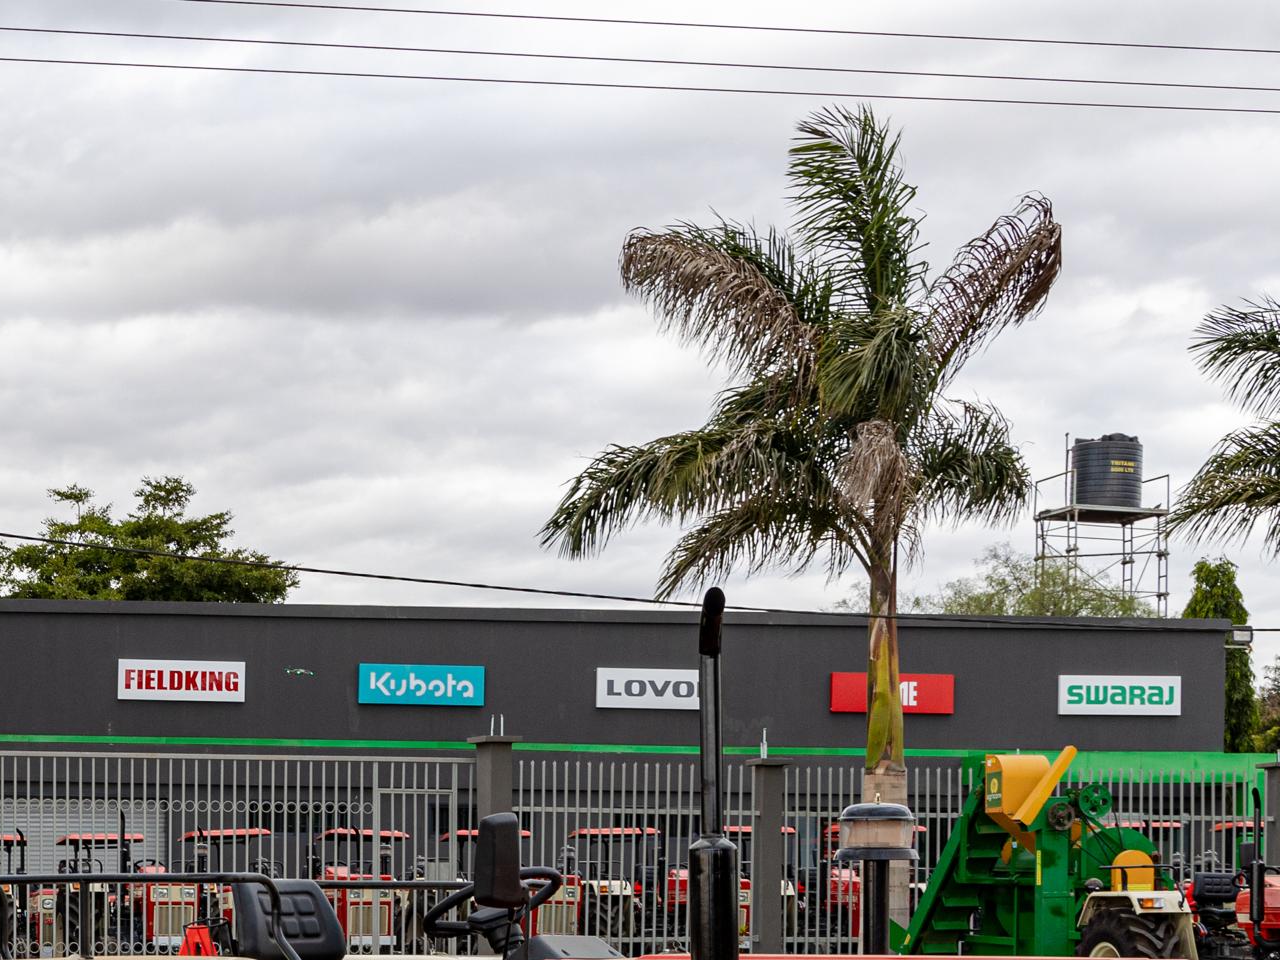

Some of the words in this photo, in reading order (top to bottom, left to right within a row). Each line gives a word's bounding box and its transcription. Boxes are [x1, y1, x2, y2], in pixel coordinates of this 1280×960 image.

[124, 668, 239, 692] FIELDKING
[369, 671, 475, 698] Kubota
[606, 679, 700, 699] LOVO
